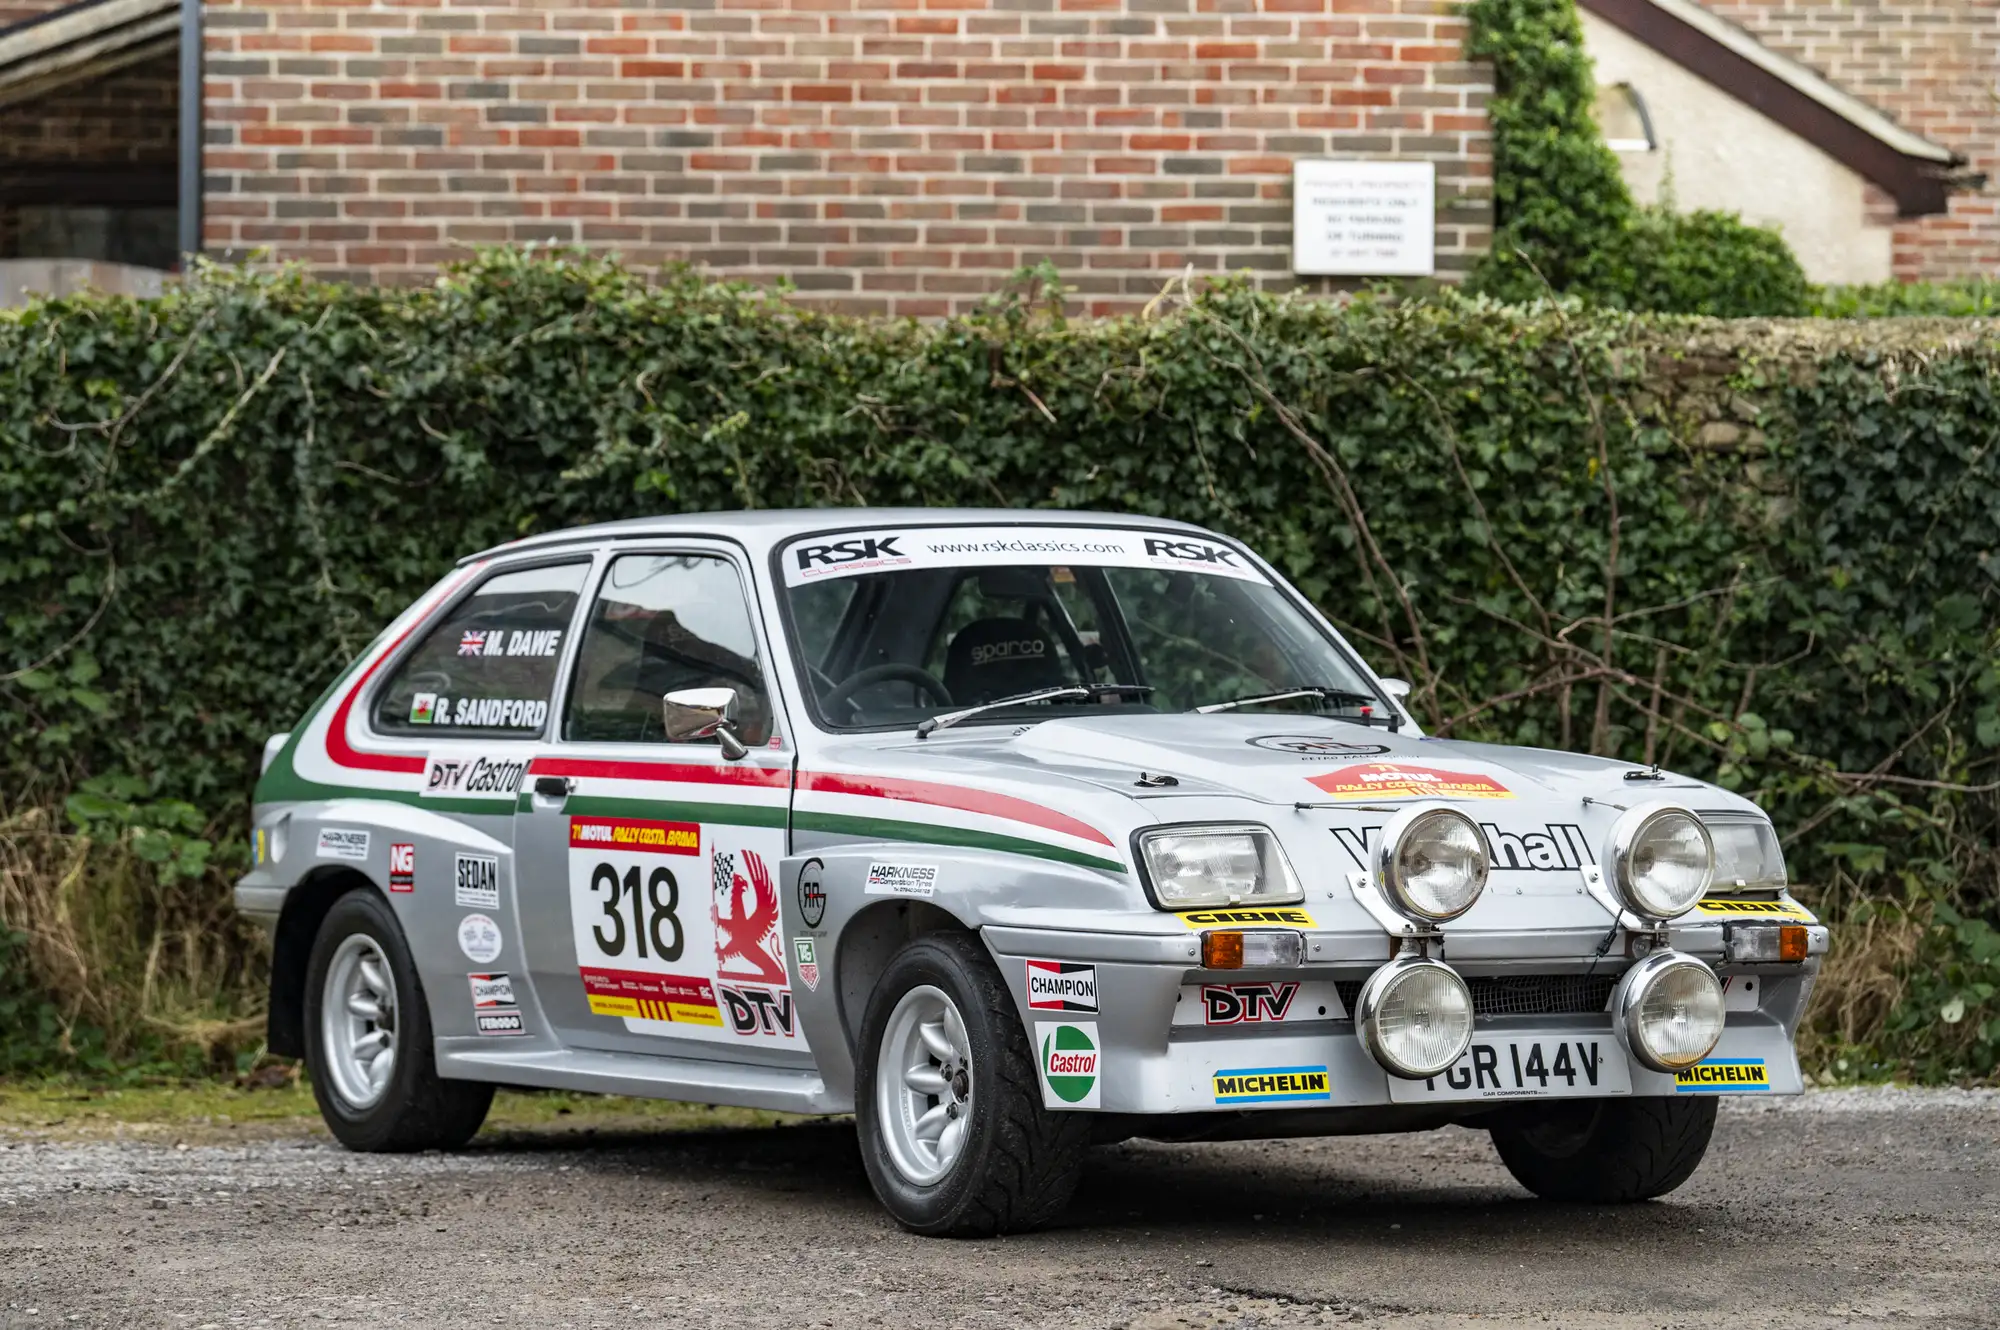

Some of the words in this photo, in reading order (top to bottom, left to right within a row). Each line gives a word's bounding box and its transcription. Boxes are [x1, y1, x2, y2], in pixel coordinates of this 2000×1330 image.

[797, 536, 905, 570] RSK
[927, 540, 1125, 554] www.rskclassics.com
[1143, 538, 1239, 568] RSK
[802, 558, 911, 577] CLASSICS
[483, 631, 503, 656] M.
[506, 630, 562, 657] DAWE
[971, 639, 1045, 664] sparco
[434, 697, 450, 725] R.
[454, 698, 547, 727] SANDFORD
[428, 761, 470, 789] DTV
[466, 756, 532, 792] Castrol
[1335, 783, 1384, 791] RALLY
[1385, 781, 1435, 790] COSTA
[1437, 783, 1496, 791] BRAVA
[1360, 773, 1442, 782] MOTUL
[581, 824, 612, 842] MOTUL
[612, 826, 640, 843] RALLY
[639, 828, 665, 845] COSTA
[666, 830, 698, 848] BRAVA
[1329, 823, 1597, 871] Vhall
[390, 845, 414, 872] NG
[458, 858, 496, 891] SEDAN
[870, 865, 936, 880] HARKNESS
[591, 862, 684, 963] 318
[474, 984, 512, 997] CHAMPION
[1031, 976, 1094, 998] CHAMPION
[719, 986, 793, 1035] DTV
[1203, 984, 1297, 1023] DTV
[1050, 1051, 1096, 1074] Castrol
[1510, 1042, 1598, 1088] 144V
[1678, 1066, 1764, 1082] MICHELIN
[1216, 1074, 1324, 1094] MICHELIN
